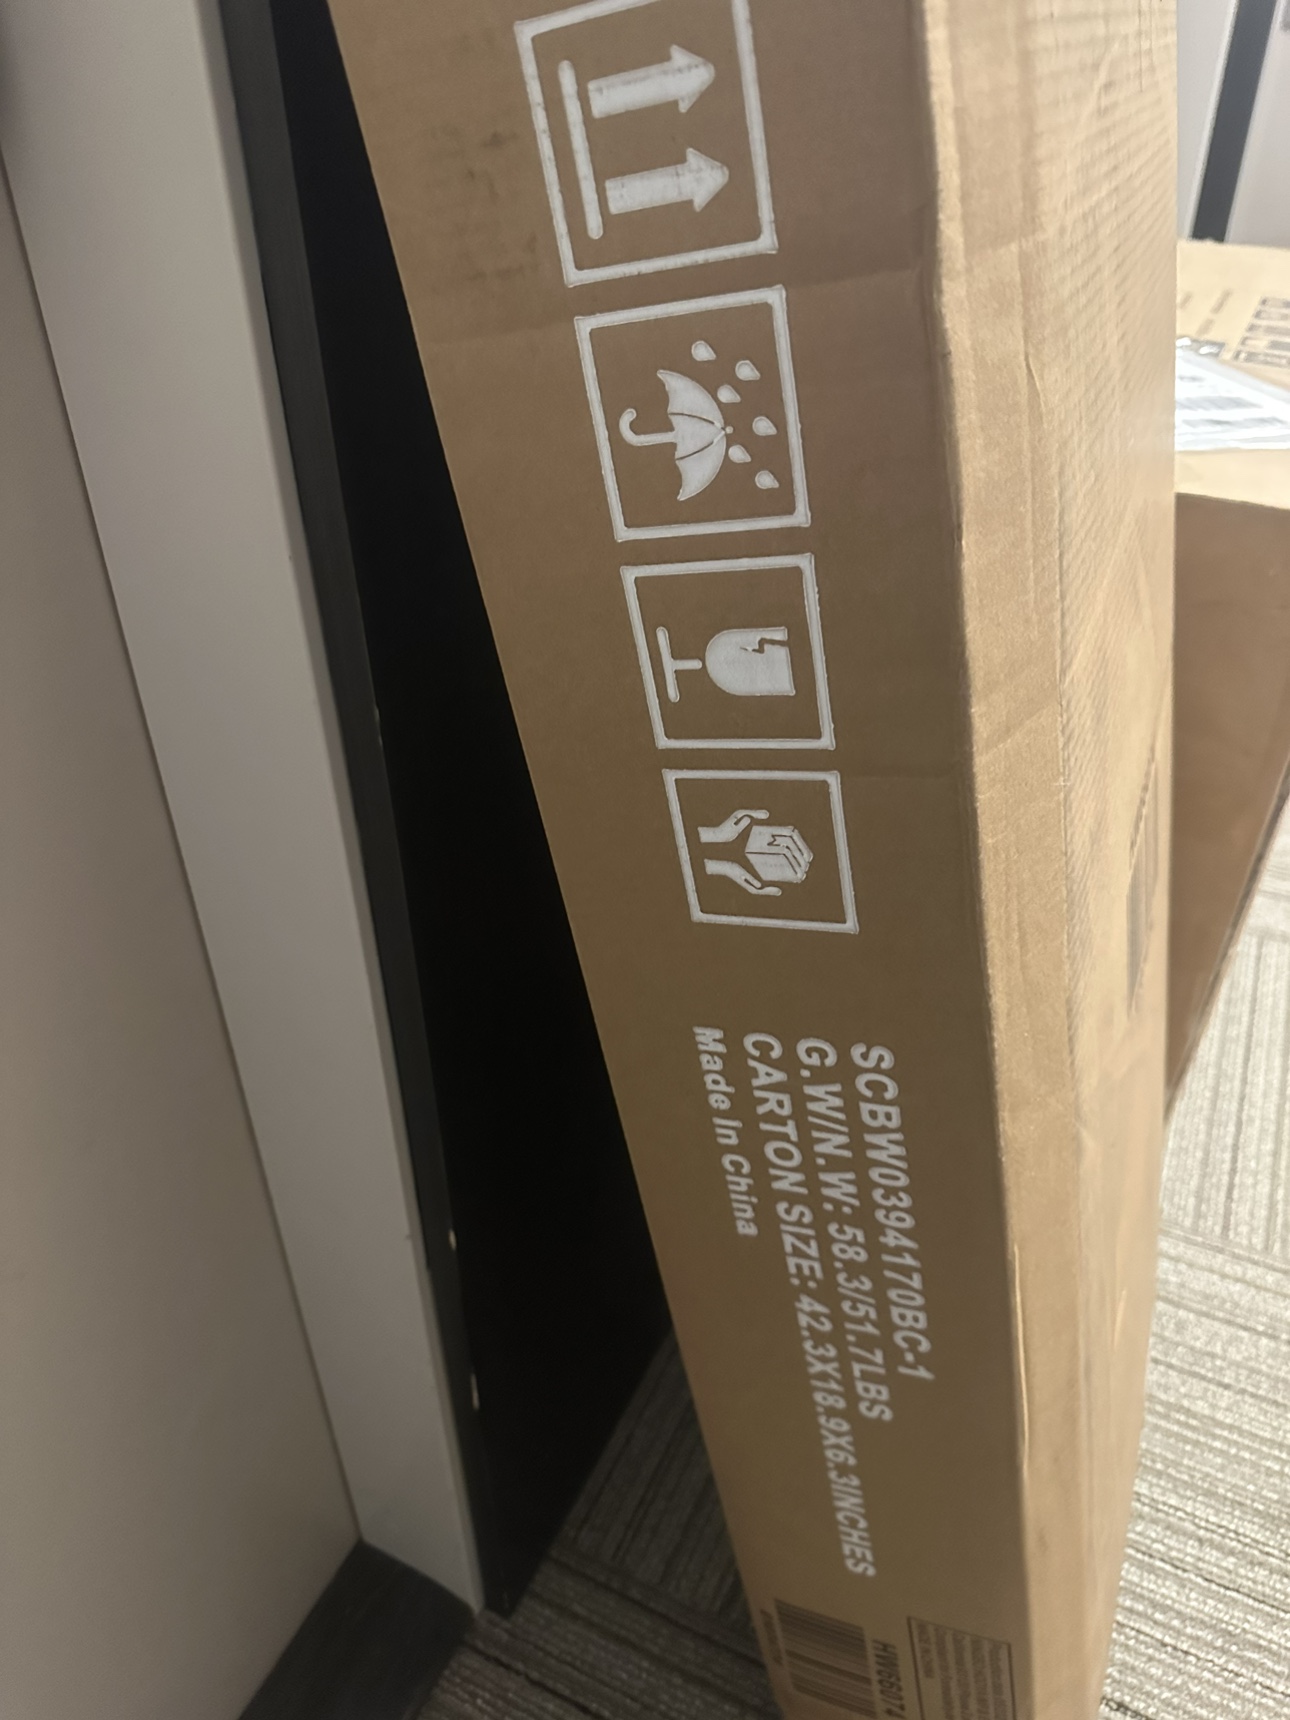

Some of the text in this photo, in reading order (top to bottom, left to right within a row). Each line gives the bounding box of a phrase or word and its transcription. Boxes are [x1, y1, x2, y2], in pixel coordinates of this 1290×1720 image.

[693, 1026, 758, 1237] Made In China
[743, 1032, 876, 1577] CARTON SIZE: 42.3X18.9X6.3INCHES
[796, 1037, 893, 1422] G.W/N.W: 58.3/51.7LBS
[850, 1042, 935, 1381] SCBW0394170BC-1
